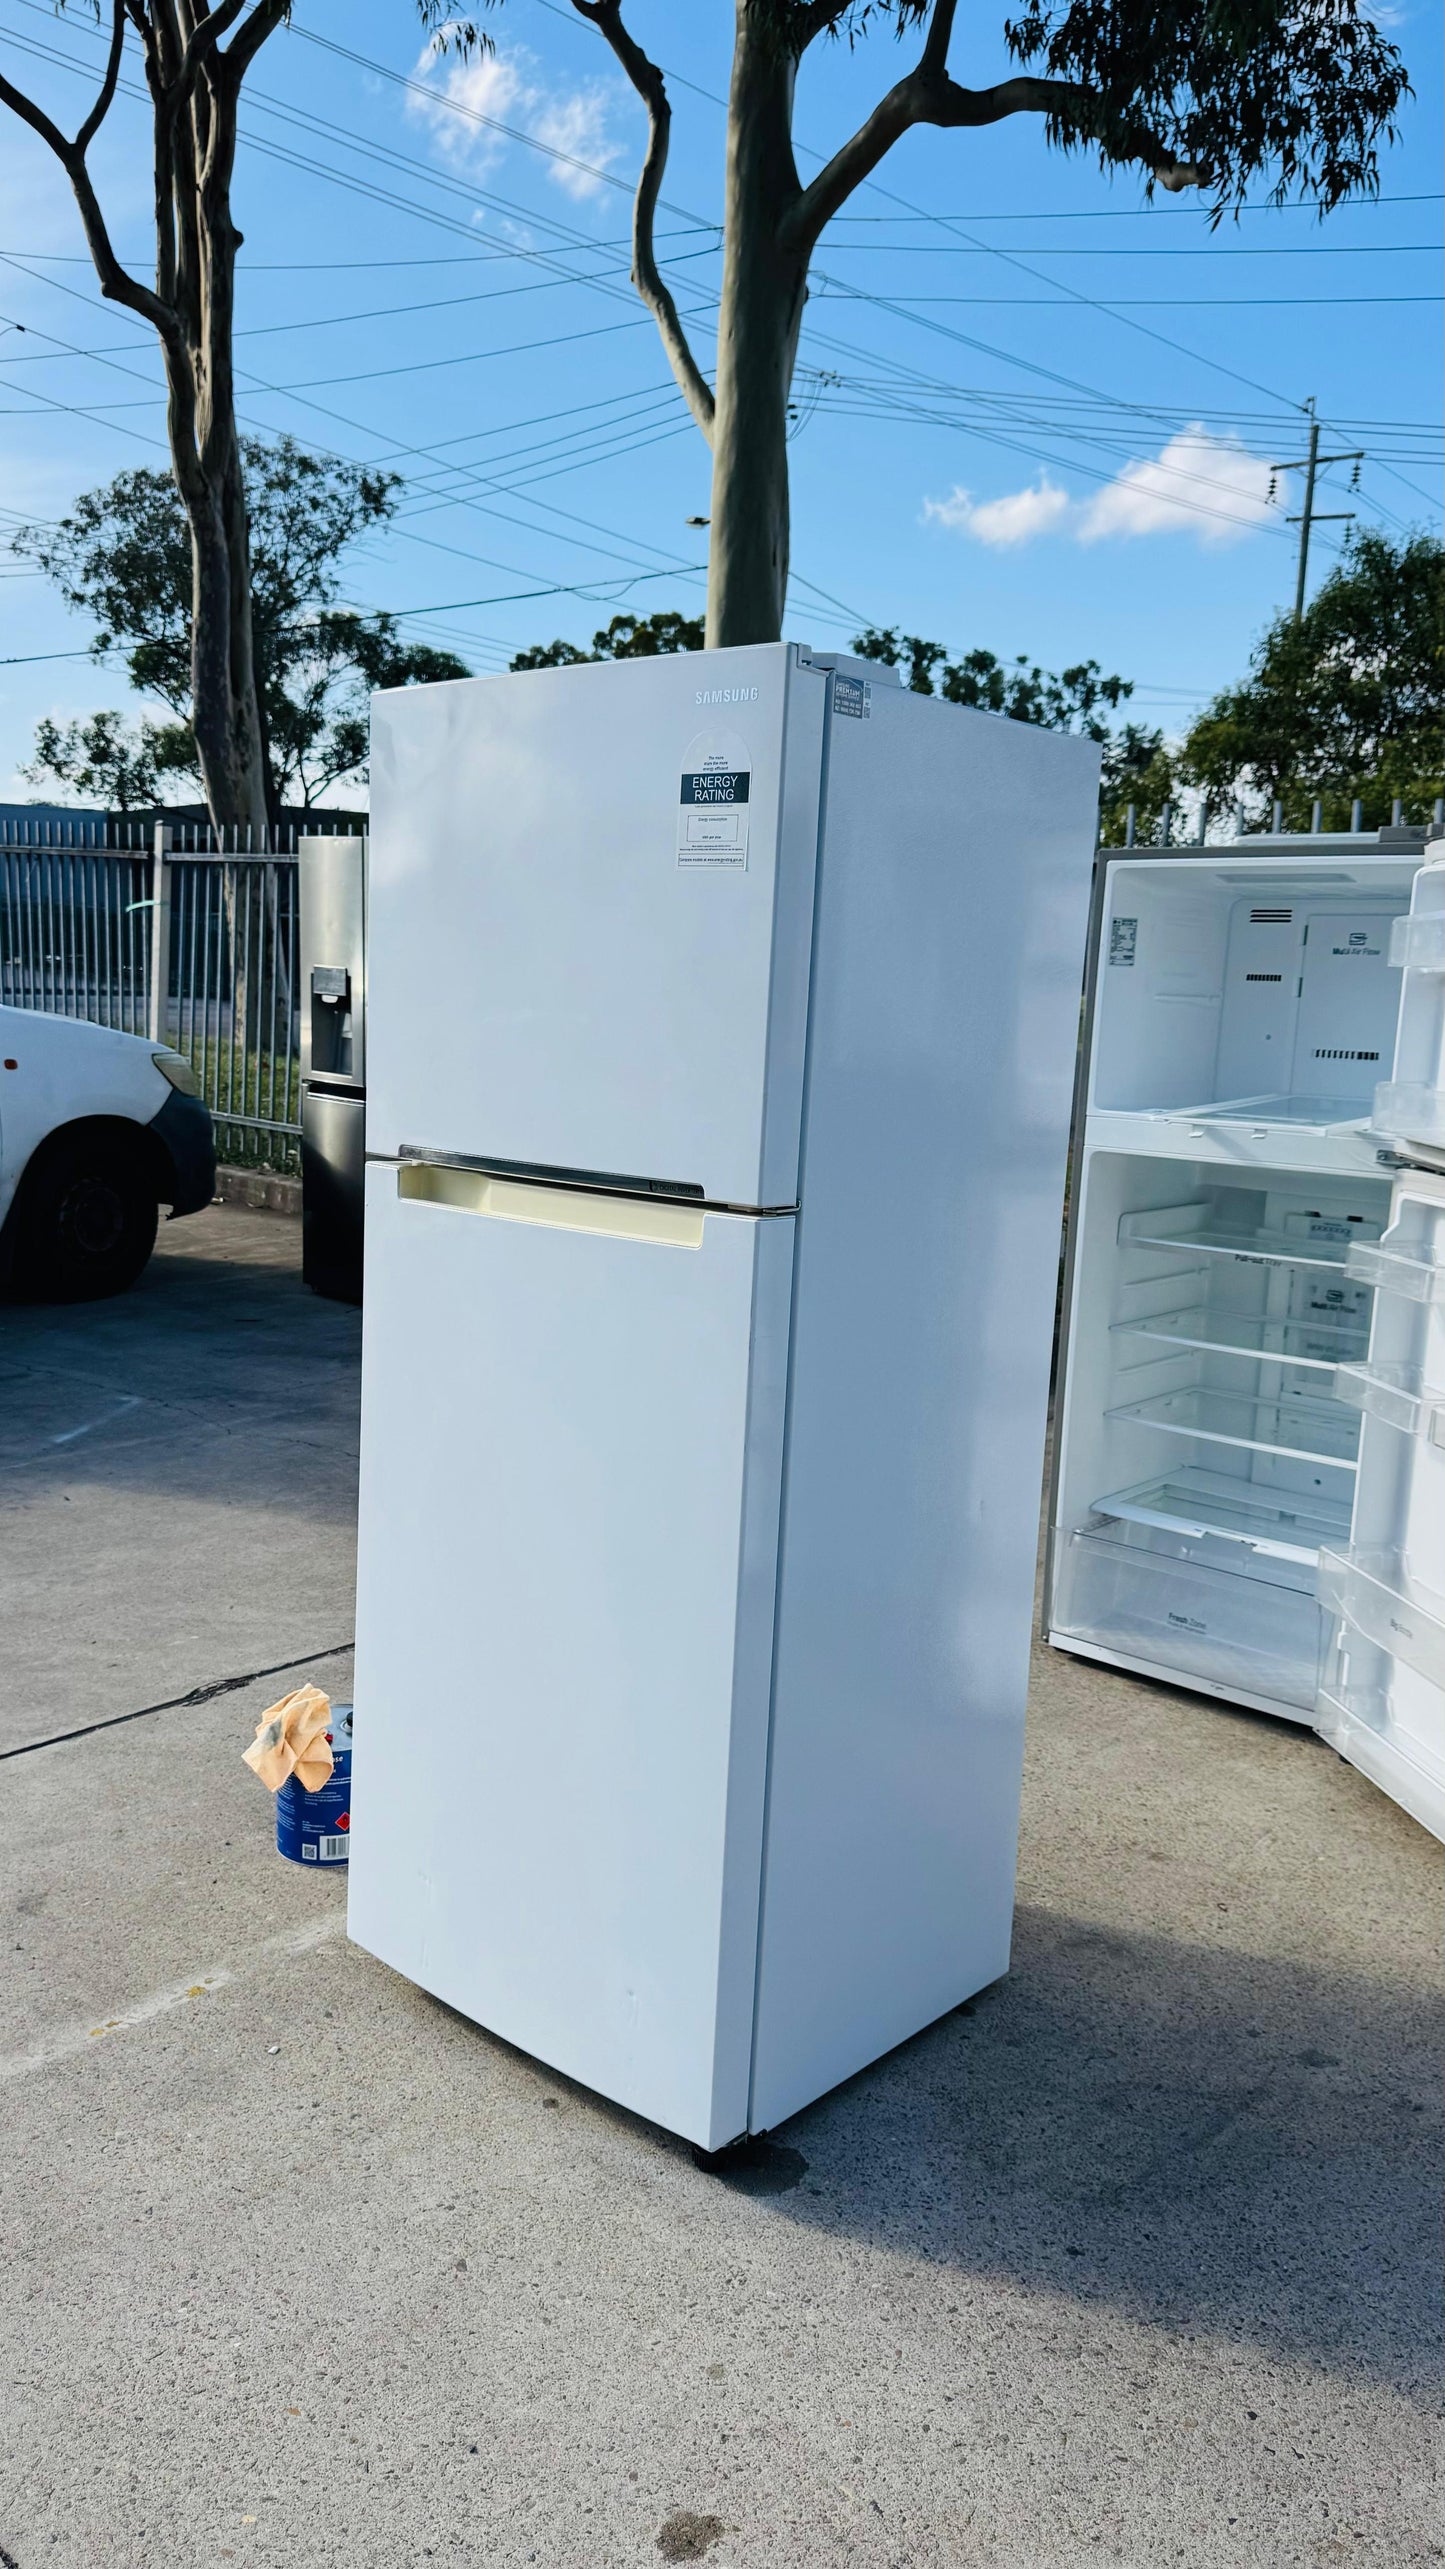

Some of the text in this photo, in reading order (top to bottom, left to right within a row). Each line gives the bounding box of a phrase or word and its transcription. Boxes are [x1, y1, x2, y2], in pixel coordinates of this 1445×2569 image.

[695, 687, 759, 705] SAMSUNG
[692, 775, 738, 788] ENERGY
[694, 788, 735, 801] RATING
